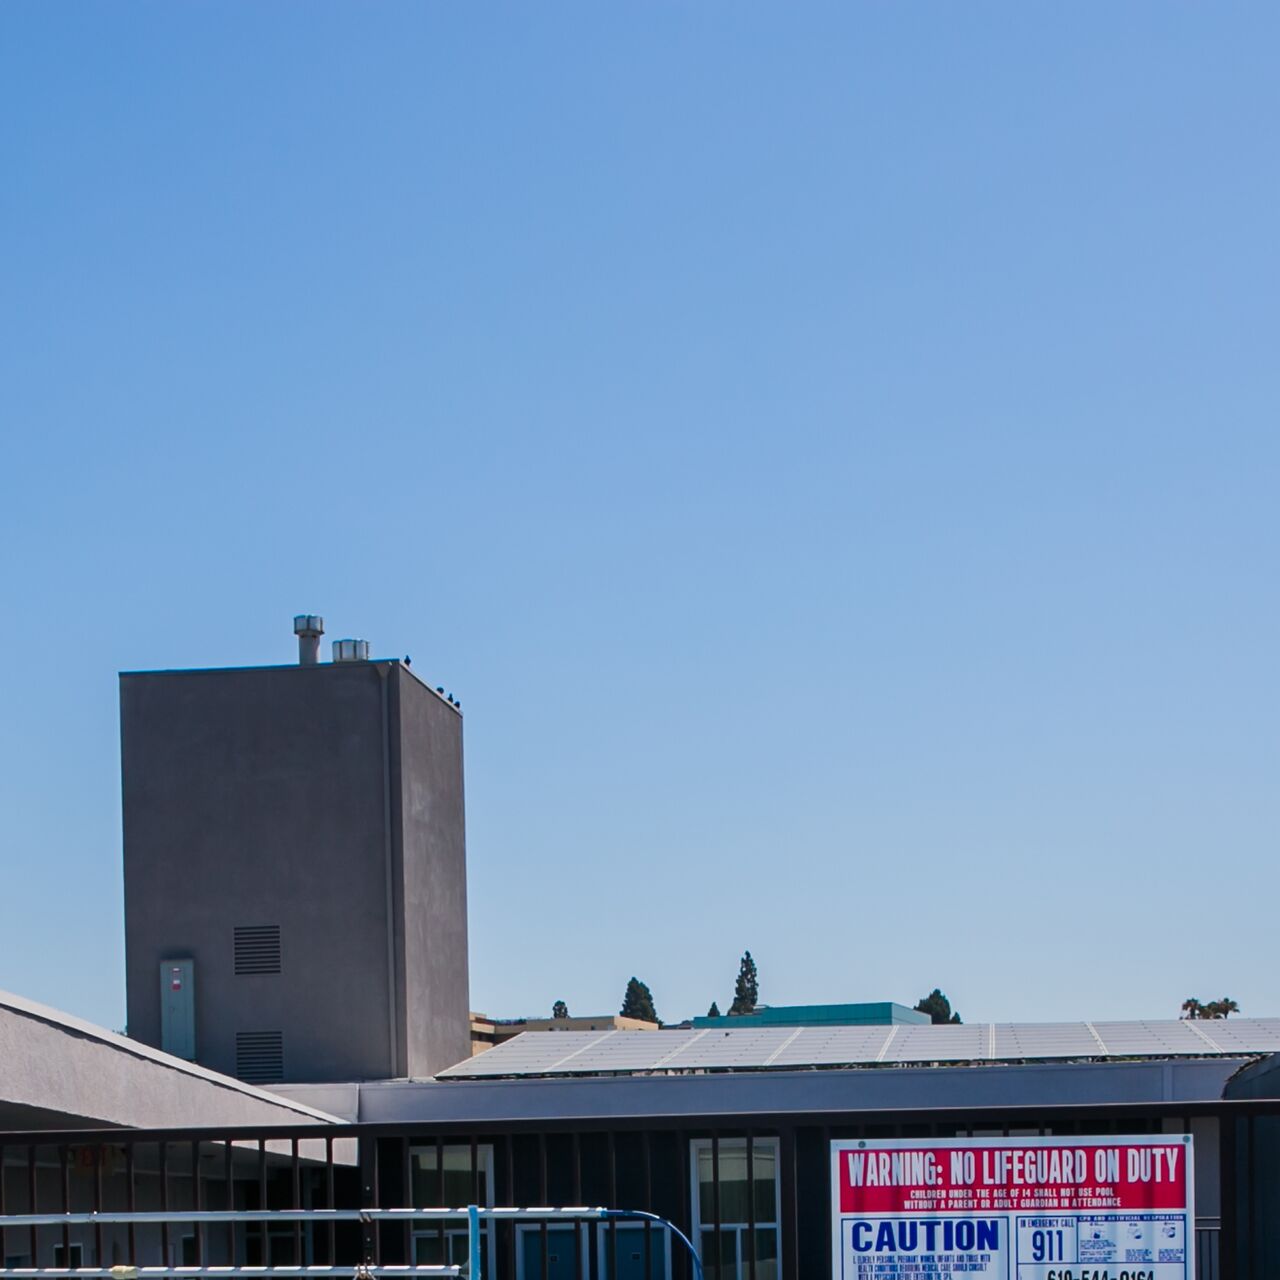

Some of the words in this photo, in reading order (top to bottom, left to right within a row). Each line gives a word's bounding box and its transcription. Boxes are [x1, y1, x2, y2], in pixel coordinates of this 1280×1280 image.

[848, 1151, 943, 1187] WARNING:
[950, 1151, 975, 1185] NO
[983, 1150, 1087, 1185] LIFEGUARD
[1094, 1149, 1119, 1183] ON
[1127, 1148, 1178, 1183] DUTY
[904, 1200, 937, 1209] WITHOUT
[940, 1200, 945, 1209] A
[948, 1200, 978, 1209] PARENT
[981, 1200, 990, 1208] OR
[994, 1199, 1017, 1208] ADULT
[1021, 1199, 1058, 1208] GUARDIAN
[1061, 1199, 1069, 1207] IN
[1072, 1198, 1121, 1207] ATTENDANCE
[910, 1189, 946, 1198] CHILDREN
[949, 1189, 972, 1198] UNDER
[976, 1189, 989, 1198] THE
[993, 1189, 1007, 1198] AGE
[1010, 1189, 1020, 1197] OF
[1022, 1188, 1030, 1197] 14
[1034, 1188, 1057, 1197] SHALL
[1060, 1188, 1074, 1197] NOT
[1078, 1188, 1093, 1196] USE
[1096, 1188, 1114, 1196] POOL
[1020, 1219, 1026, 1228] IN
[1028, 1219, 1060, 1227] EMERGENCY
[1061, 1218, 1074, 1227] CALL
[852, 1220, 999, 1252] CAUTION
[1032, 1230, 1063, 1261] 911
